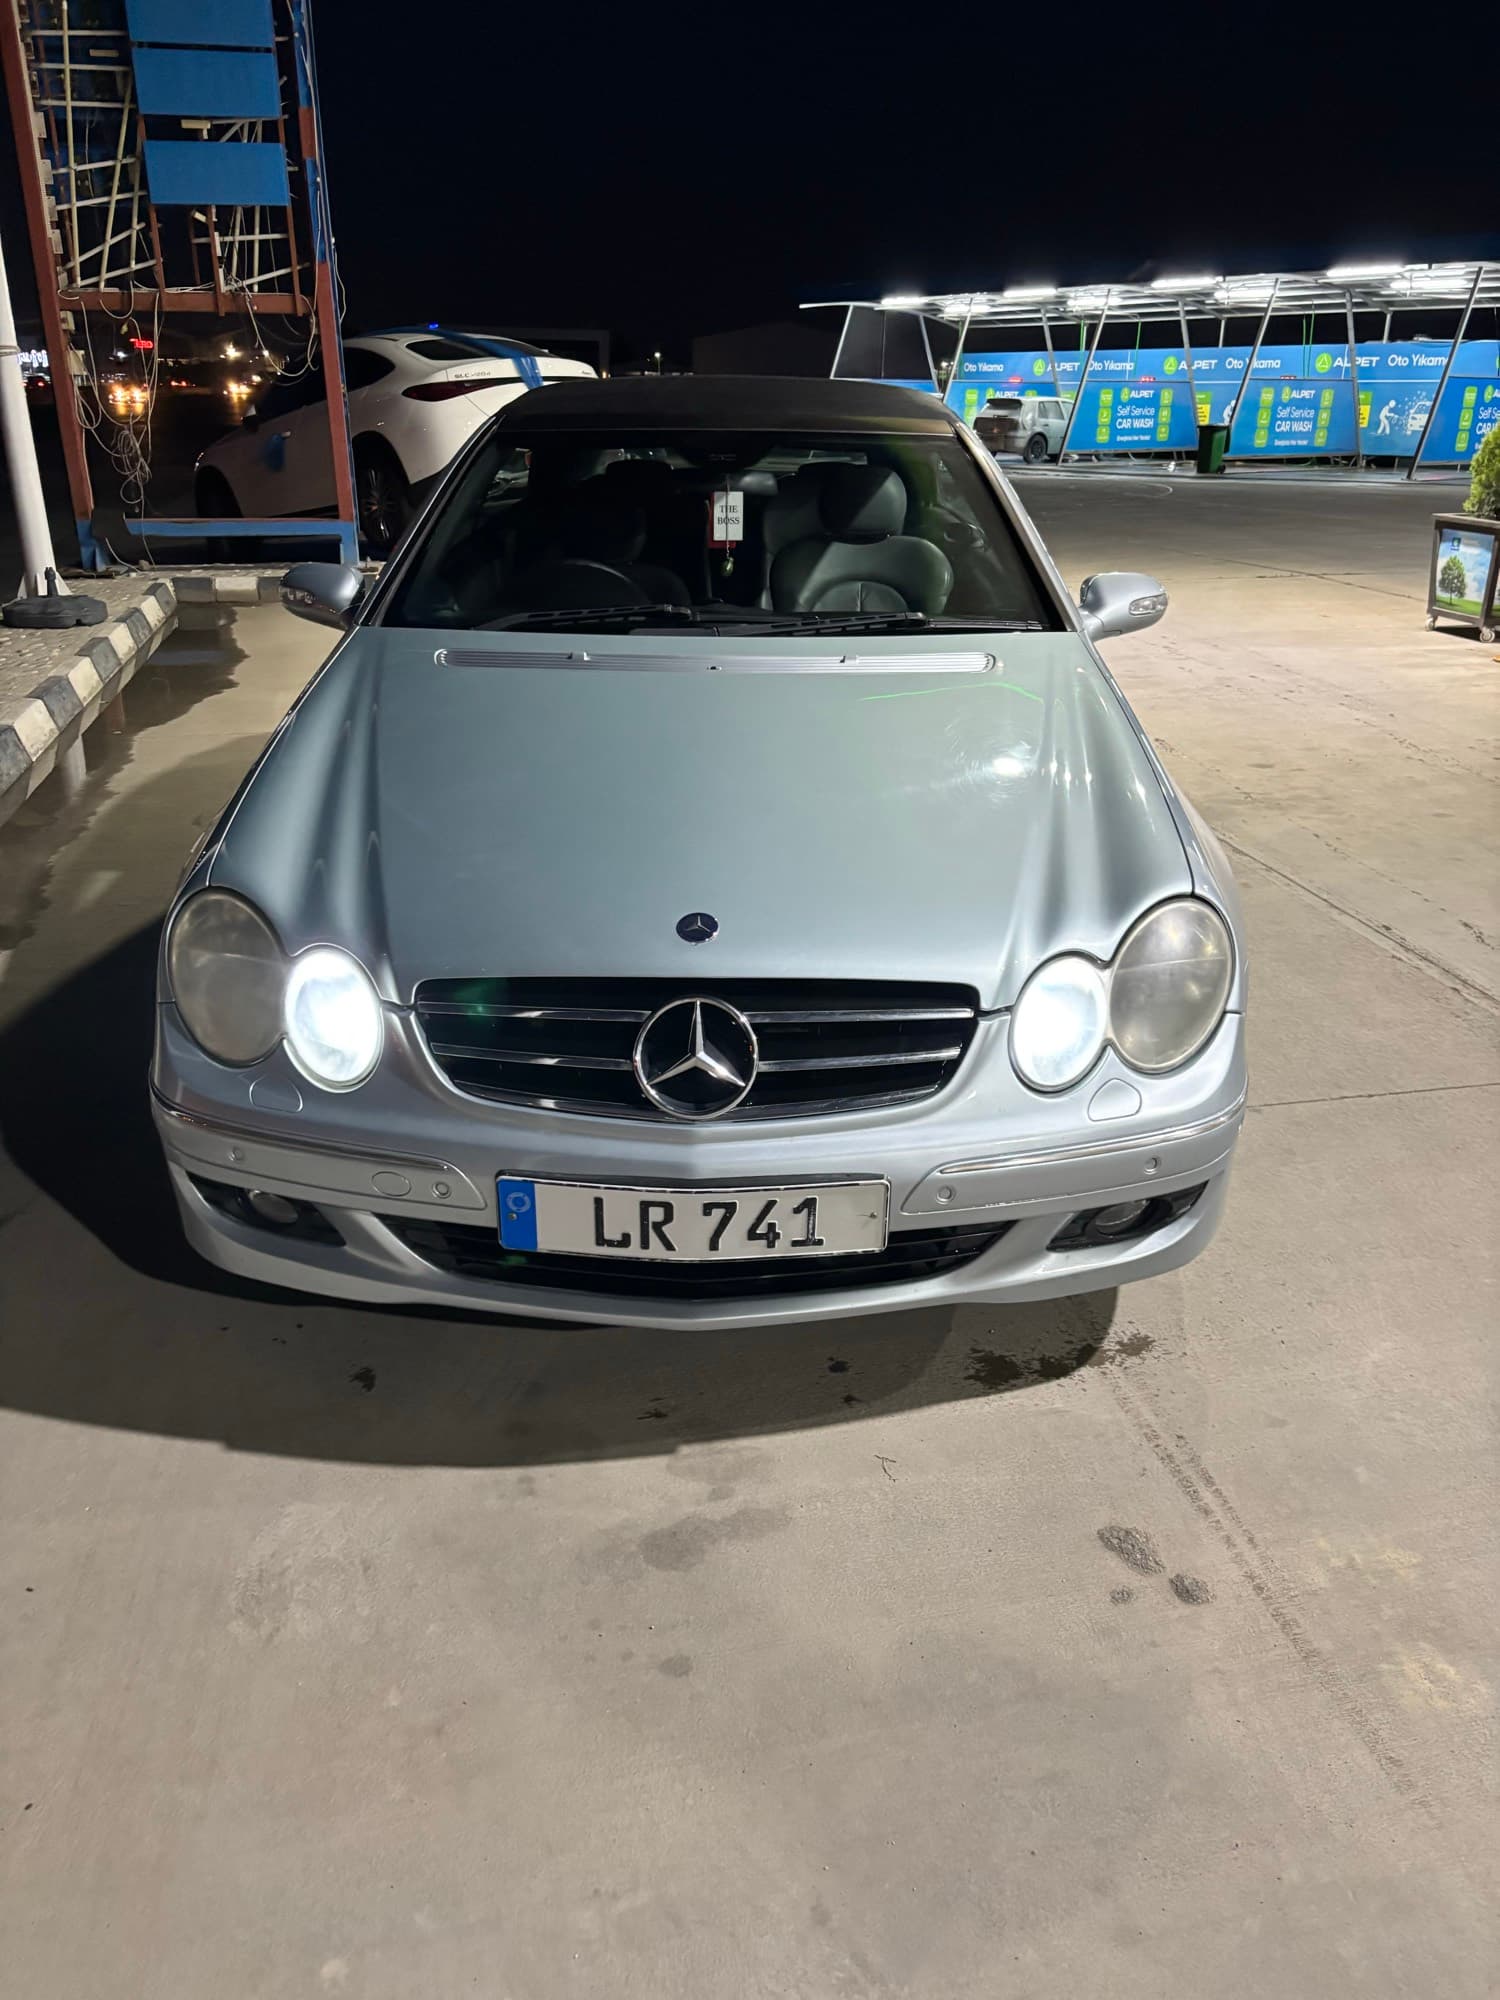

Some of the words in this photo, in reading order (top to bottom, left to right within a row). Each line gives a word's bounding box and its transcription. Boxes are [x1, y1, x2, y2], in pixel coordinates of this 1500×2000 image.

[1178, 359, 1218, 370] APET
[1225, 357, 1244, 369] Oto
[1387, 354, 1410, 367] Oto
[963, 361, 977, 373] Oto
[1129, 389, 1155, 399] ALPET
[1290, 389, 1316, 399] ALPET
[1117, 405, 1131, 417] Self
[1131, 406, 1155, 417] Service
[1276, 406, 1291, 418] Self
[1290, 407, 1315, 419] Service
[1116, 418, 1132, 430] CAR
[1132, 418, 1154, 429] WASH
[1274, 421, 1290, 433] CAR
[1291, 421, 1313, 433] WASH
[719, 504, 738, 513] THE
[717, 516, 740, 525] BOSS
[593, 1196, 678, 1252] LR
[702, 1196, 825, 1252] 741
